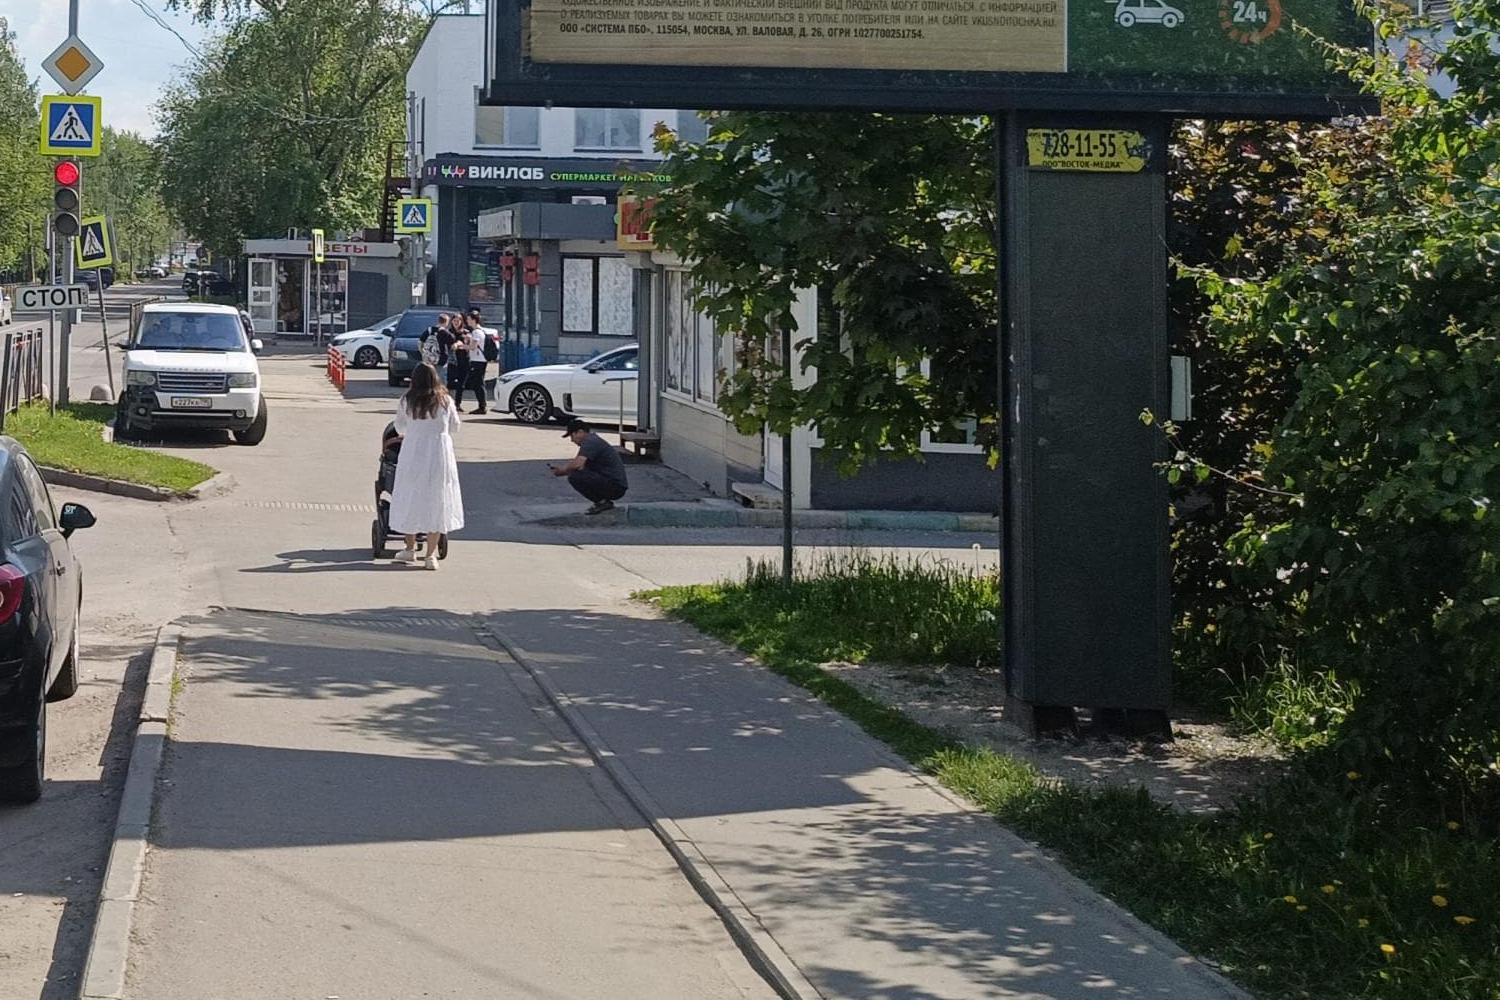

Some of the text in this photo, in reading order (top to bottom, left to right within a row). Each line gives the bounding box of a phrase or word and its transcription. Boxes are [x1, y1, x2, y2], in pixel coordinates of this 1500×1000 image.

[560, 23, 578, 33] ООО
[657, 24, 690, 36] 115054,
[693, 26, 733, 36] МОСКВА,
[752, 26, 796, 38] ВАЛОВАЯ,
[827, 27, 851, 38] ОГРН
[550, 173, 615, 182] СУПЕРМАРКЕТ
[23, 288, 81, 307] СТОП
